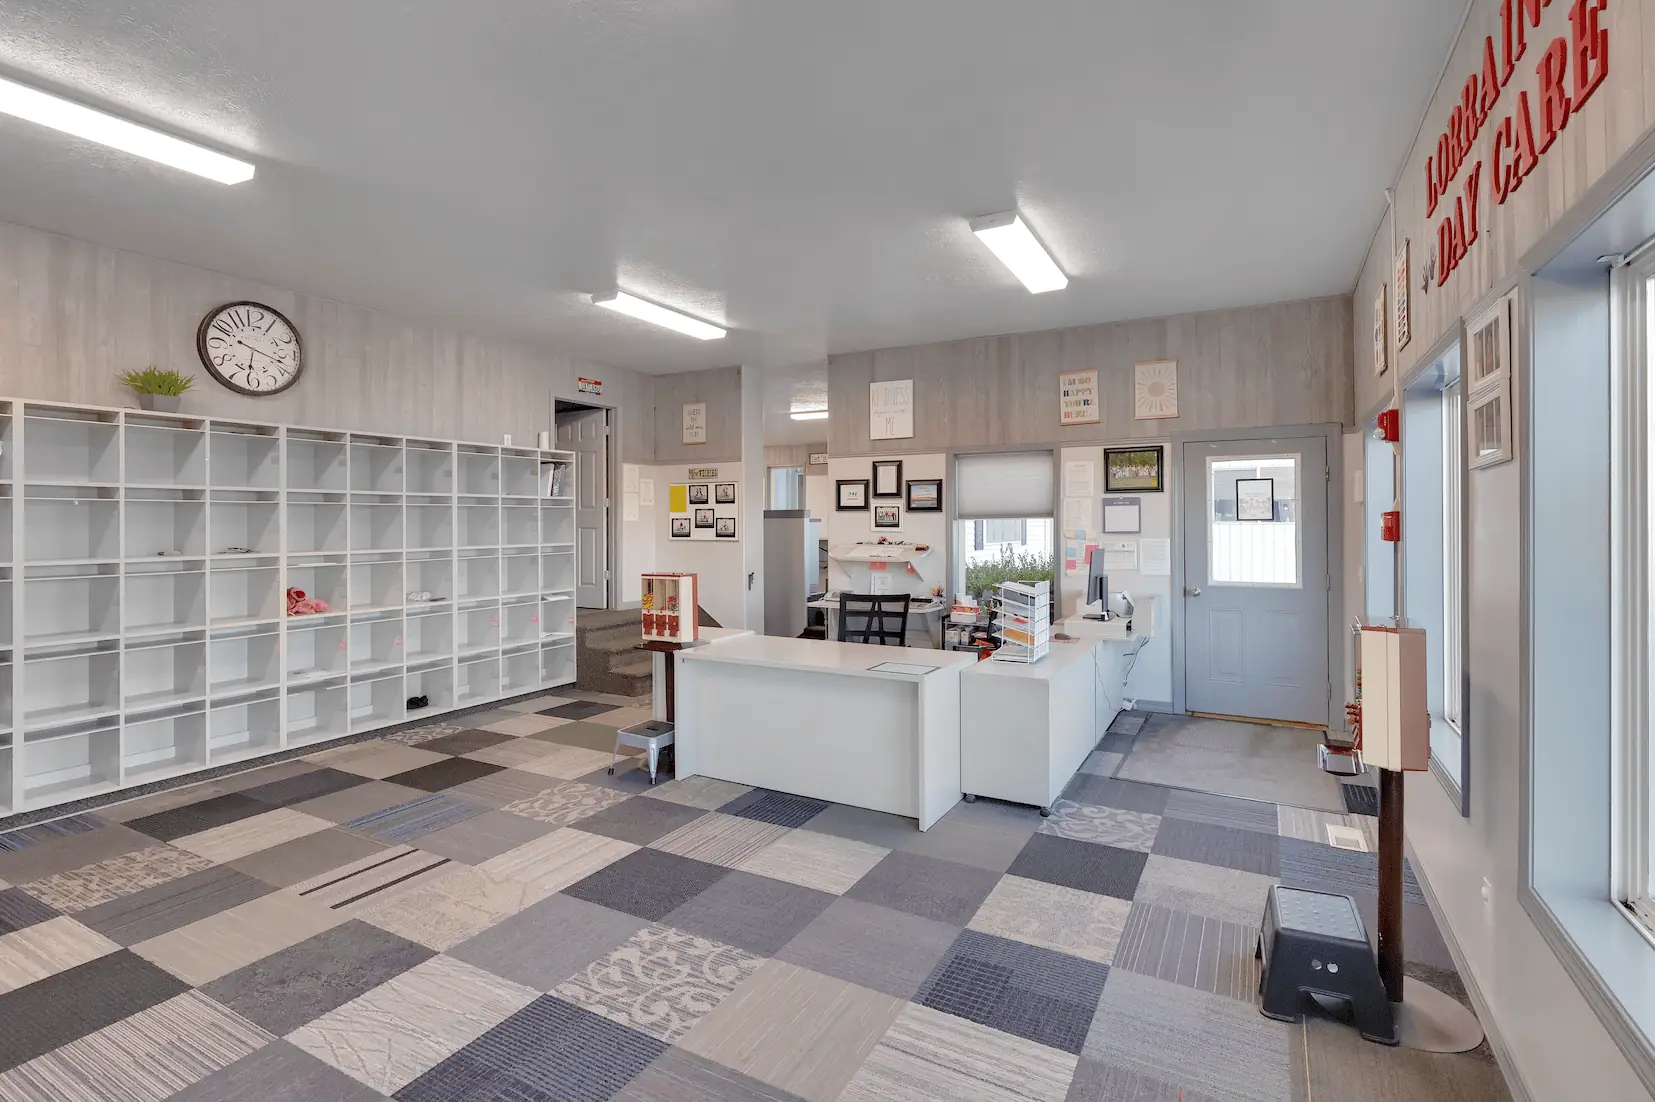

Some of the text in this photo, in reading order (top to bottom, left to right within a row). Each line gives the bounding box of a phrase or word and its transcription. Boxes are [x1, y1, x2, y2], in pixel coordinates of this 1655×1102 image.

[1425, 0, 1553, 219] LORRAIN
[1437, 0, 1608, 287] DAY CARE
[212, 319, 234, 337] 10
[228, 310, 246, 329] 11
[247, 309, 264, 329] 12
[265, 319, 277, 334] 1
[208, 337, 229, 350] 9
[272, 332, 292, 347] 2
[213, 353, 232, 367] 8
[277, 348, 296, 362] 3
[228, 363, 246, 380] 7
[246, 370, 261, 389] 6
[263, 369, 278, 388] 5
[872, 386, 910, 407] KIDNESS
